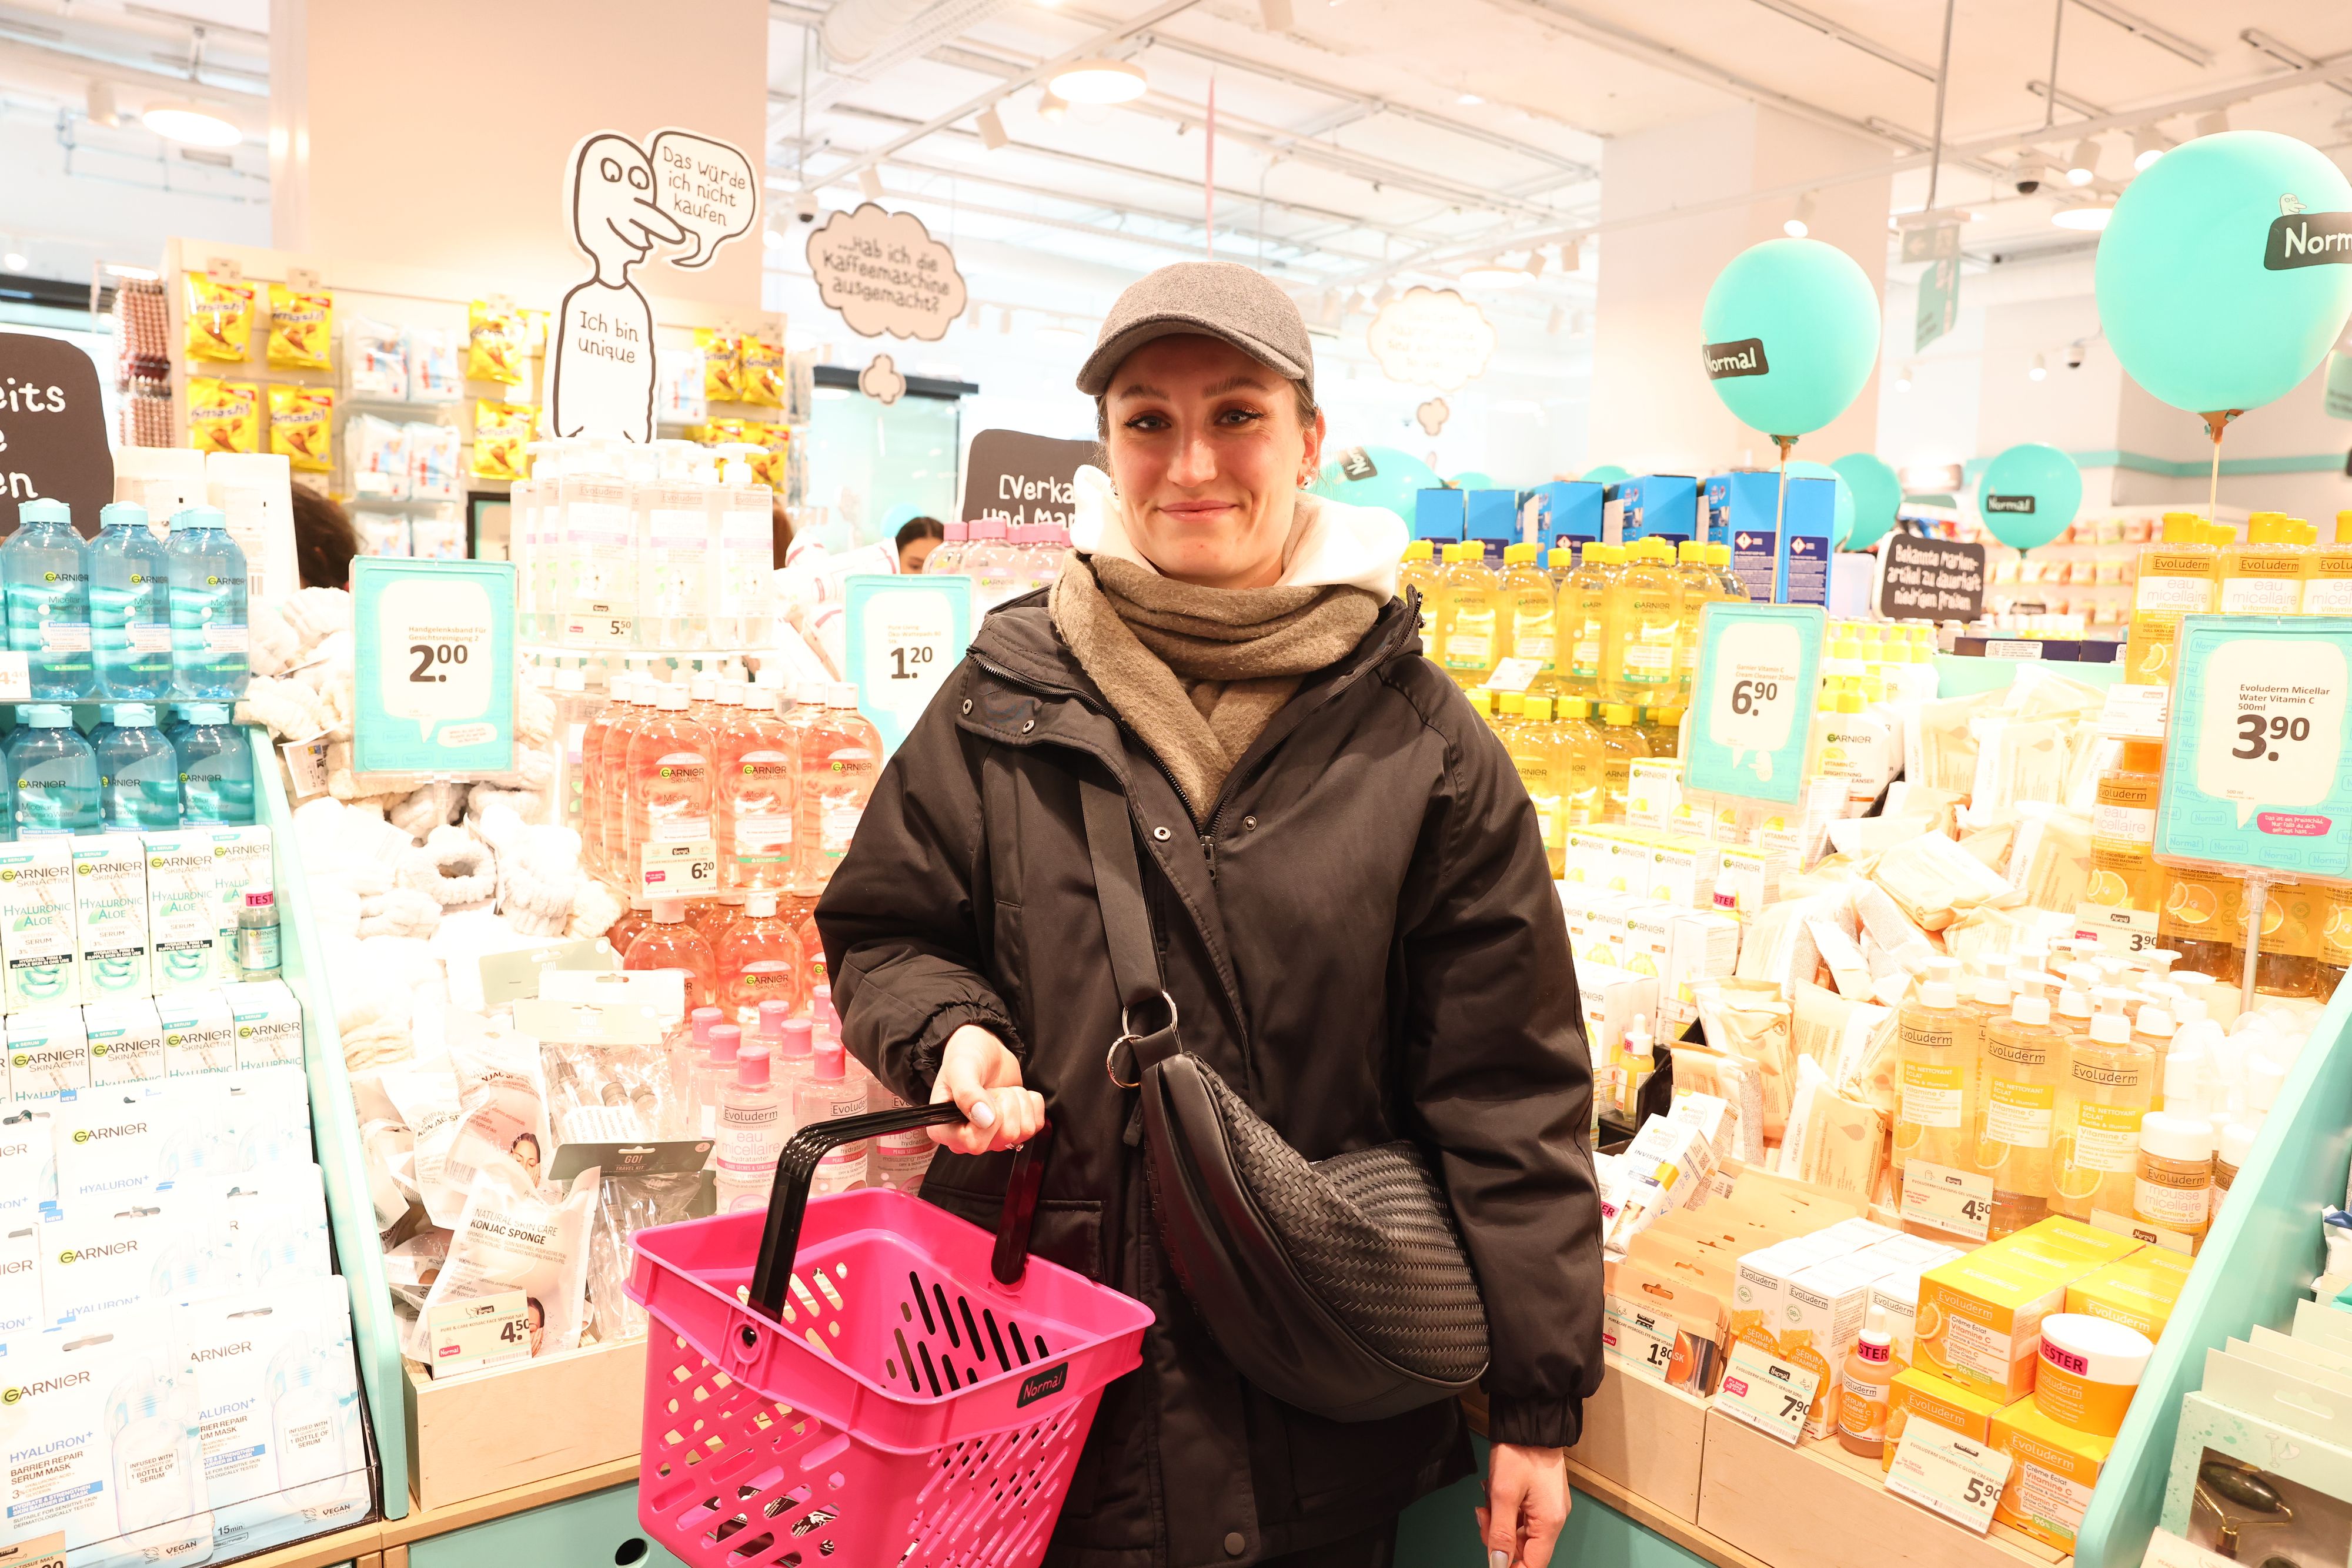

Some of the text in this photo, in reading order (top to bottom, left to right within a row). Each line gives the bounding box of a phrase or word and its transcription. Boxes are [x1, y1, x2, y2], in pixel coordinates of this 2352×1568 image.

[663, 146, 746, 189] Das würde
[669, 171, 736, 207] ich nicht
[674, 193, 727, 226] kaufen
[2285, 222, 2352, 258] Norm
[887, 243, 912, 264] ich
[916, 252, 938, 272] die
[823, 250, 950, 295] Kaffeemaschine
[831, 276, 940, 314] ausgemacht?
[580, 311, 639, 342] Ich bin
[578, 339, 635, 363] unique
[1703, 347, 1757, 372] Normal
[1000, 474, 1075, 504] [Verka
[1988, 497, 2030, 510] Normal
[1895, 544, 1939, 566] Bekannte
[2155, 559, 2209, 570] Evoluderm
[2241, 560, 2298, 571] Evoluderm
[1887, 566, 1982, 591] artikel zu dauerhaft
[2167, 580, 2194, 589] eau
[2254, 580, 2283, 590] eau
[1894, 586, 1971, 611] niedrigen Preisen
[2147, 590, 2207, 603] micellaire
[2233, 593, 2296, 606] micellaire
[610, 620, 631, 635] 5.50
[409, 634, 473, 643] Gesichtsreinigung
[410, 644, 467, 682] 2.00
[891, 647, 933, 679] 1.20
[1732, 680, 1778, 716] 6.90
[2240, 684, 2331, 695] Evoluderm Micellar
[2270, 695, 2306, 704] Vitamin
[2232, 714, 2310, 761] 3.90
[2104, 807, 2127, 819] eau
[79, 861, 142, 875] GARNIER
[152, 856, 212, 868] GARNIER
[2, 867, 69, 881] GARNIER
[691, 862, 714, 880] 6.20
[80, 897, 143, 910] HYALURONIC
[152, 891, 212, 902] HYALURONIC
[4, 903, 71, 917] HYALURONIC
[98, 909, 126, 920] ALOE
[170, 902, 196, 912] ALOE
[24, 915, 53, 927] ALOE
[168, 1029, 231, 1047] GARNIER
[240, 1022, 300, 1038] GARNIER
[93, 1039, 160, 1057] GARNIER
[1989, 1044, 2046, 1064] Evoluderm
[2074, 1065, 2138, 1084] Evoluderm
[2006, 1082, 2043, 1094] NETTOYANT
[724, 1108, 778, 1121] Evoluderm
[2096, 1106, 2136, 1116] NETTOYANT
[74, 1122, 148, 1142] GARNIER
[737, 1132, 762, 1142] eau
[722, 1141, 780, 1155] micellaire
[1634, 1149, 1667, 1164] INVISIBLE
[624, 1155, 643, 1164] GO!
[2148, 1168, 2204, 1185] Evoluderm
[1936, 1185, 1957, 1194] CLEANSING
[2150, 1186, 2199, 1201] mousse
[1962, 1200, 1992, 1221] 4.50
[2146, 1195, 2201, 1211] micellaire
[2152, 1206, 2186, 1218] Vitamine
[475, 1209, 557, 1236] NATURAL CARE
[470, 1219, 546, 1245] KONJAC SPONGE
[60, 1240, 138, 1263] GARNIER
[1939, 1290, 1993, 1319] Evoluderm
[501, 1319, 530, 1342] 4.50
[1952, 1316, 1971, 1328] Crème
[1746, 1328, 1773, 1345] SÉRUM
[1951, 1323, 1983, 1340] Vitamine
[1742, 1334, 1769, 1350] VITAMINE
[440, 1347, 459, 1356] Normal
[1647, 1343, 1672, 1366] 1.80
[1796, 1348, 1823, 1365] SÉRUM
[2041, 1339, 2083, 1372] TESTER
[1791, 1355, 1819, 1372] VITAMINE
[1736, 1365, 1776, 1387] EVOLUDERM VITAMIN
[1770, 1367, 1789, 1381] Normal
[4, 1371, 91, 1402] GARNIER
[1023, 1370, 1063, 1400] Normal
[1779, 1395, 1810, 1421] 7.90
[220, 1415, 248, 1427] REPAIR
[289, 1424, 313, 1435] INFUSED
[215, 1426, 237, 1438] MASK
[295, 1433, 319, 1444] BOTTLE
[130, 1453, 173, 1469] INFUSED WITH
[2012, 1436, 2074, 1470] Evoluderm
[11, 1450, 83, 1477] BARRIER REPAIR
[1910, 1442, 1994, 1483] EVOLUDERM VITAMIN GLOW CREAM
[11, 1462, 71, 1486] SERUM MASK
[136, 1465, 163, 1479] BOTTLE
[2026, 1464, 2067, 1486] Crème Éclat
[2026, 1470, 2063, 1493] Vitamine
[1963, 1477, 2001, 1507] 5.90
[2024, 1490, 2050, 1507] Vitamin
[14, 1499, 83, 1524] SUITABLE SENSITIVE
[14, 1502, 95, 1529] DERMATOLOGICALLY TESTED
[323, 1504, 350, 1516] VEGAN
[2037, 1502, 2056, 1514] Cream
[166, 1540, 197, 1554] VEGAN
